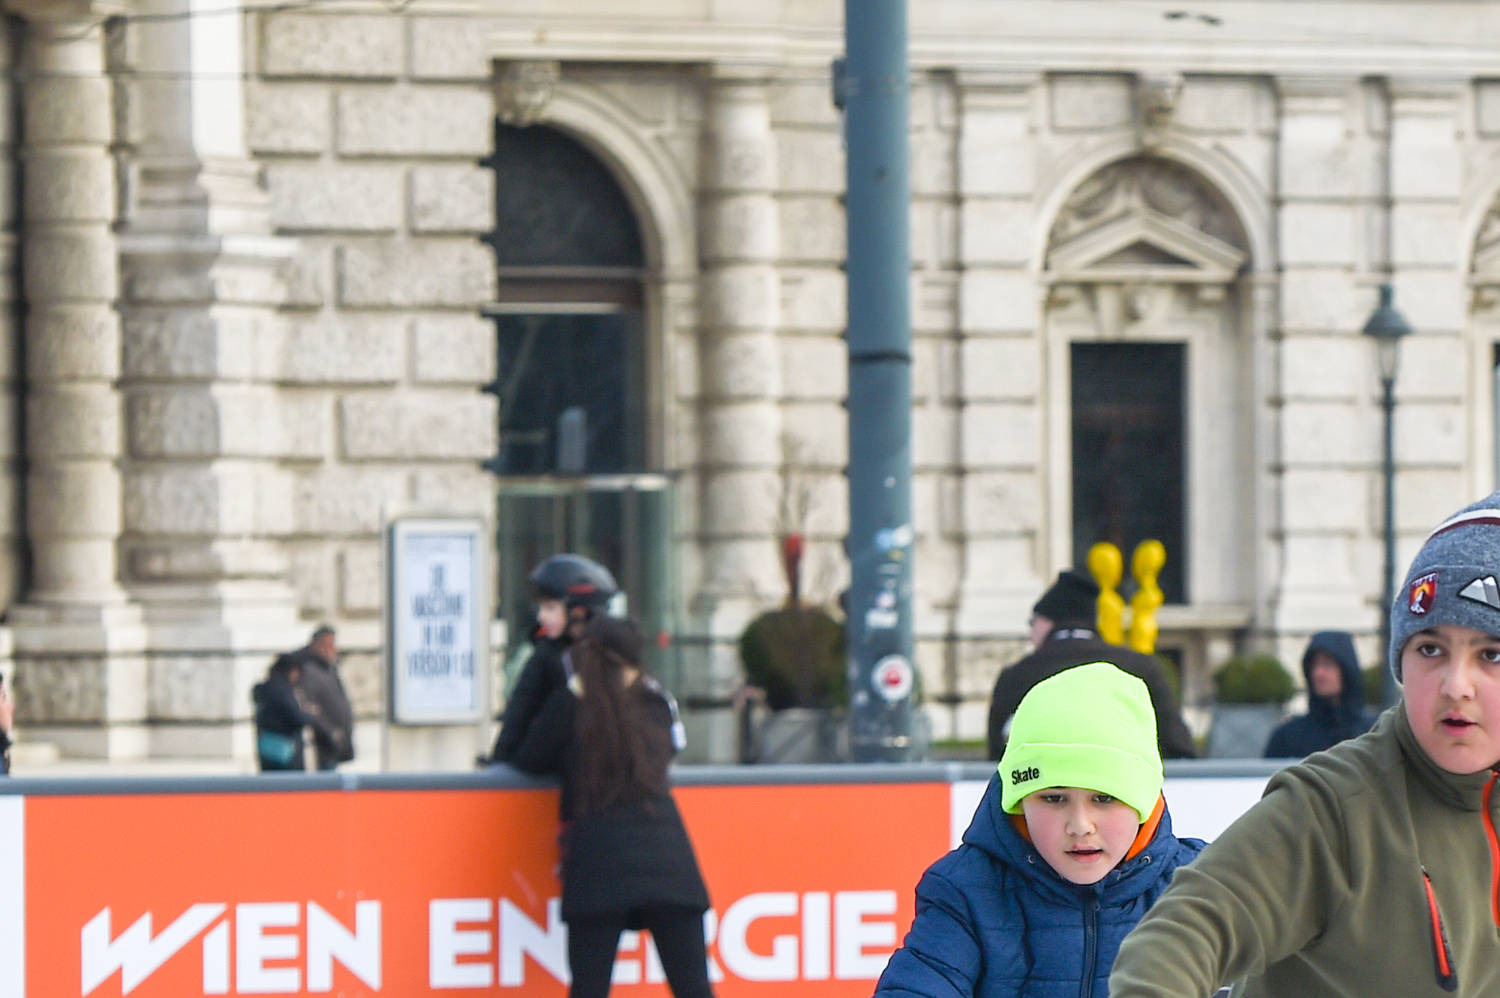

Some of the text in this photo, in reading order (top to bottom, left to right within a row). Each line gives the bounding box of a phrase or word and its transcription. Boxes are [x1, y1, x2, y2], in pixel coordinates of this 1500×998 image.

[1011, 766, 1040, 785] Skate
[81, 890, 898, 997] WIEN ENGIE
